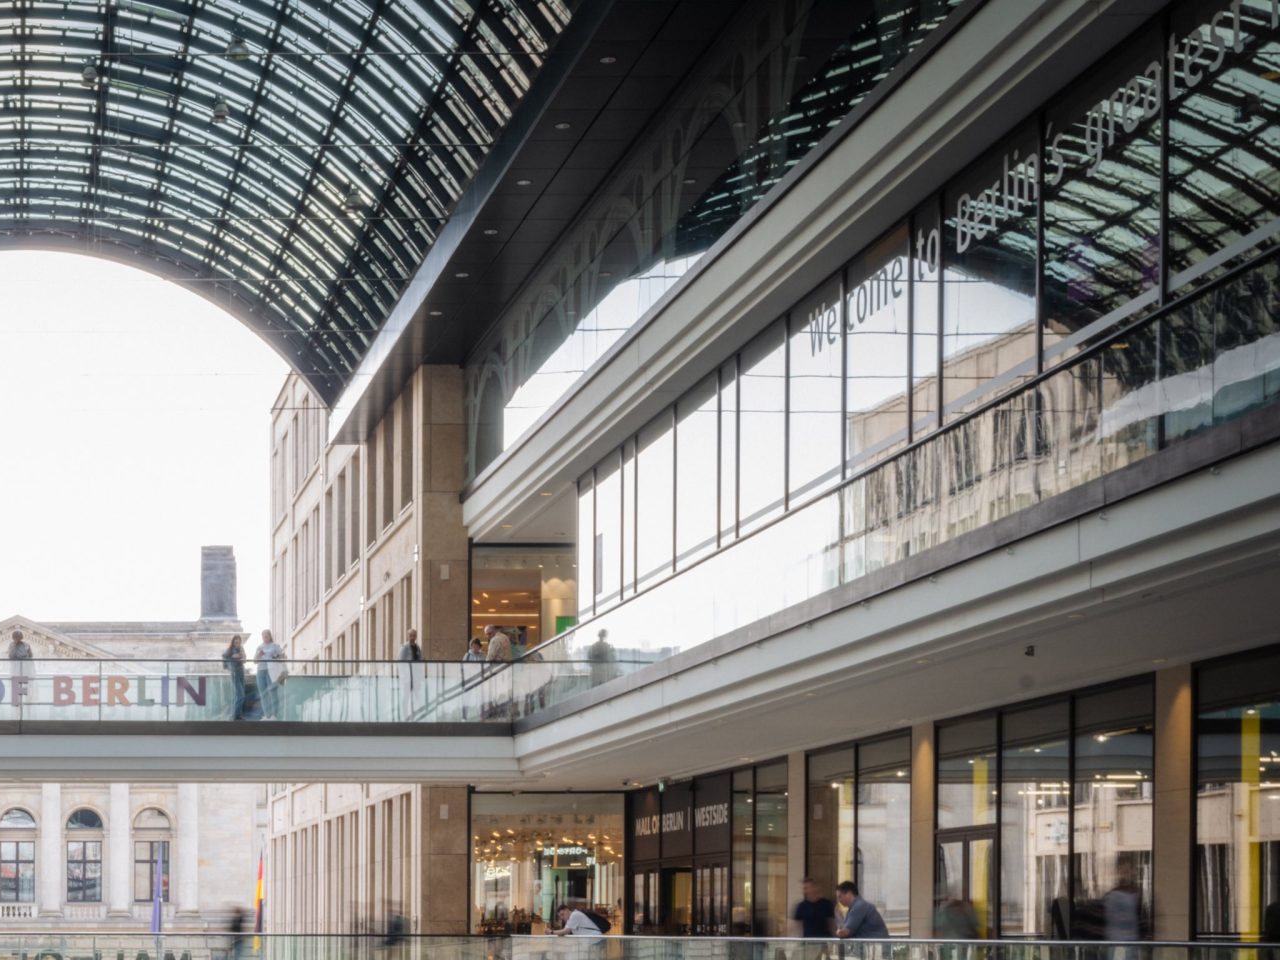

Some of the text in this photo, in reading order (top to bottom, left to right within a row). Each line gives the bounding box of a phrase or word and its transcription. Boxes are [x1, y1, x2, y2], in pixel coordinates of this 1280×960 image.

[808, 256, 903, 358] Welcome
[916, 228, 939, 280] to
[956, 124, 1064, 254] Berlin's
[52, 676, 206, 707] BERLIN
[635, 817, 651, 837] MALL
[651, 814, 660, 835] OF
[662, 811, 684, 833] BERLIN
[695, 803, 728, 828] WESTSIDE
